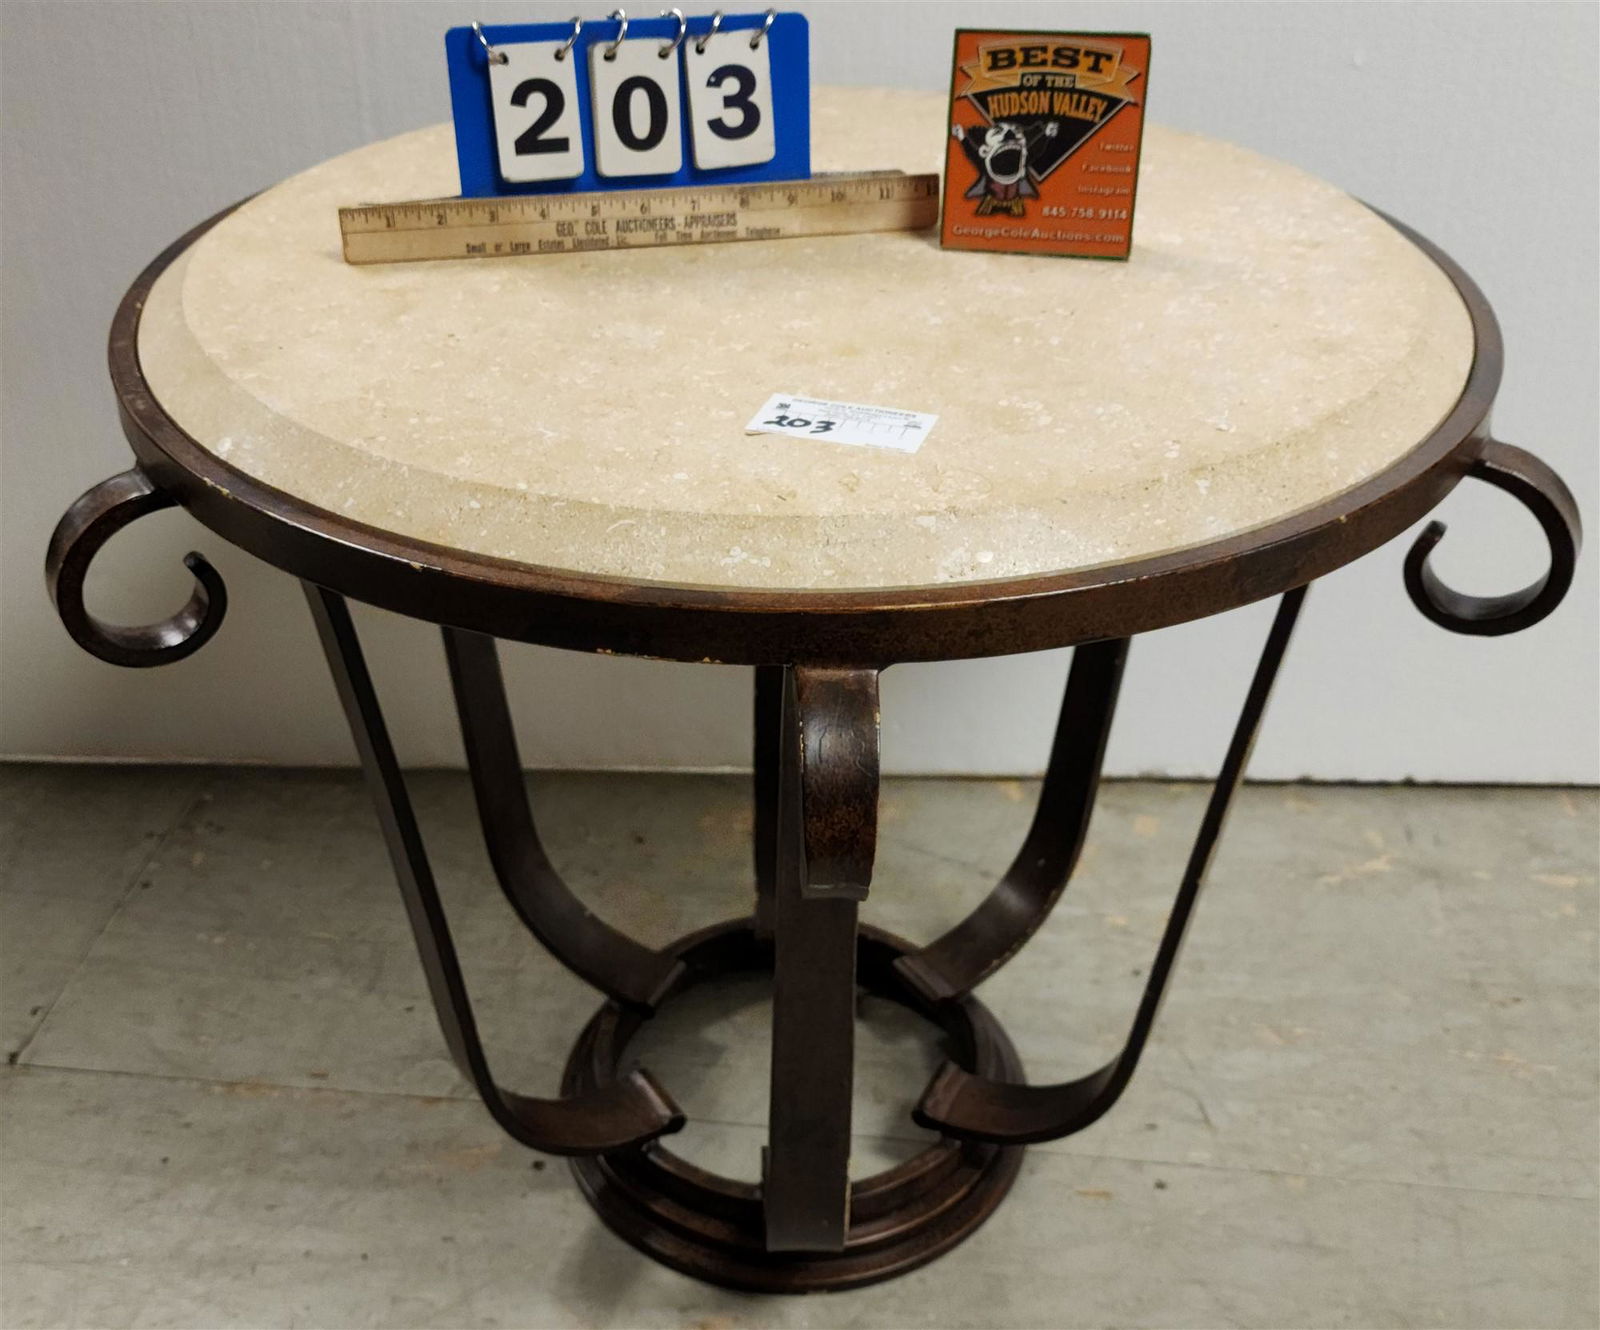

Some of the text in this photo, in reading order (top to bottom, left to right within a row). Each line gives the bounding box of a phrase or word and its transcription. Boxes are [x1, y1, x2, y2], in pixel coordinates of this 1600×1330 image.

[986, 45, 1113, 73] BEST
[1022, 74, 1075, 88] OF THE
[987, 91, 1108, 122] HUDSON VALLEY
[640, 202, 648, 214] 6
[585, 220, 607, 235] COLE
[616, 216, 676, 234] AUCTIONEERS
[684, 213, 738, 229] APPRAISERS
[953, 224, 1125, 243] GeorgeColeAuctions.com
[466, 242, 487, 254] Small
[495, 243, 503, 253] or
[510, 241, 531, 253] Large
[763, 414, 836, 433] 203
